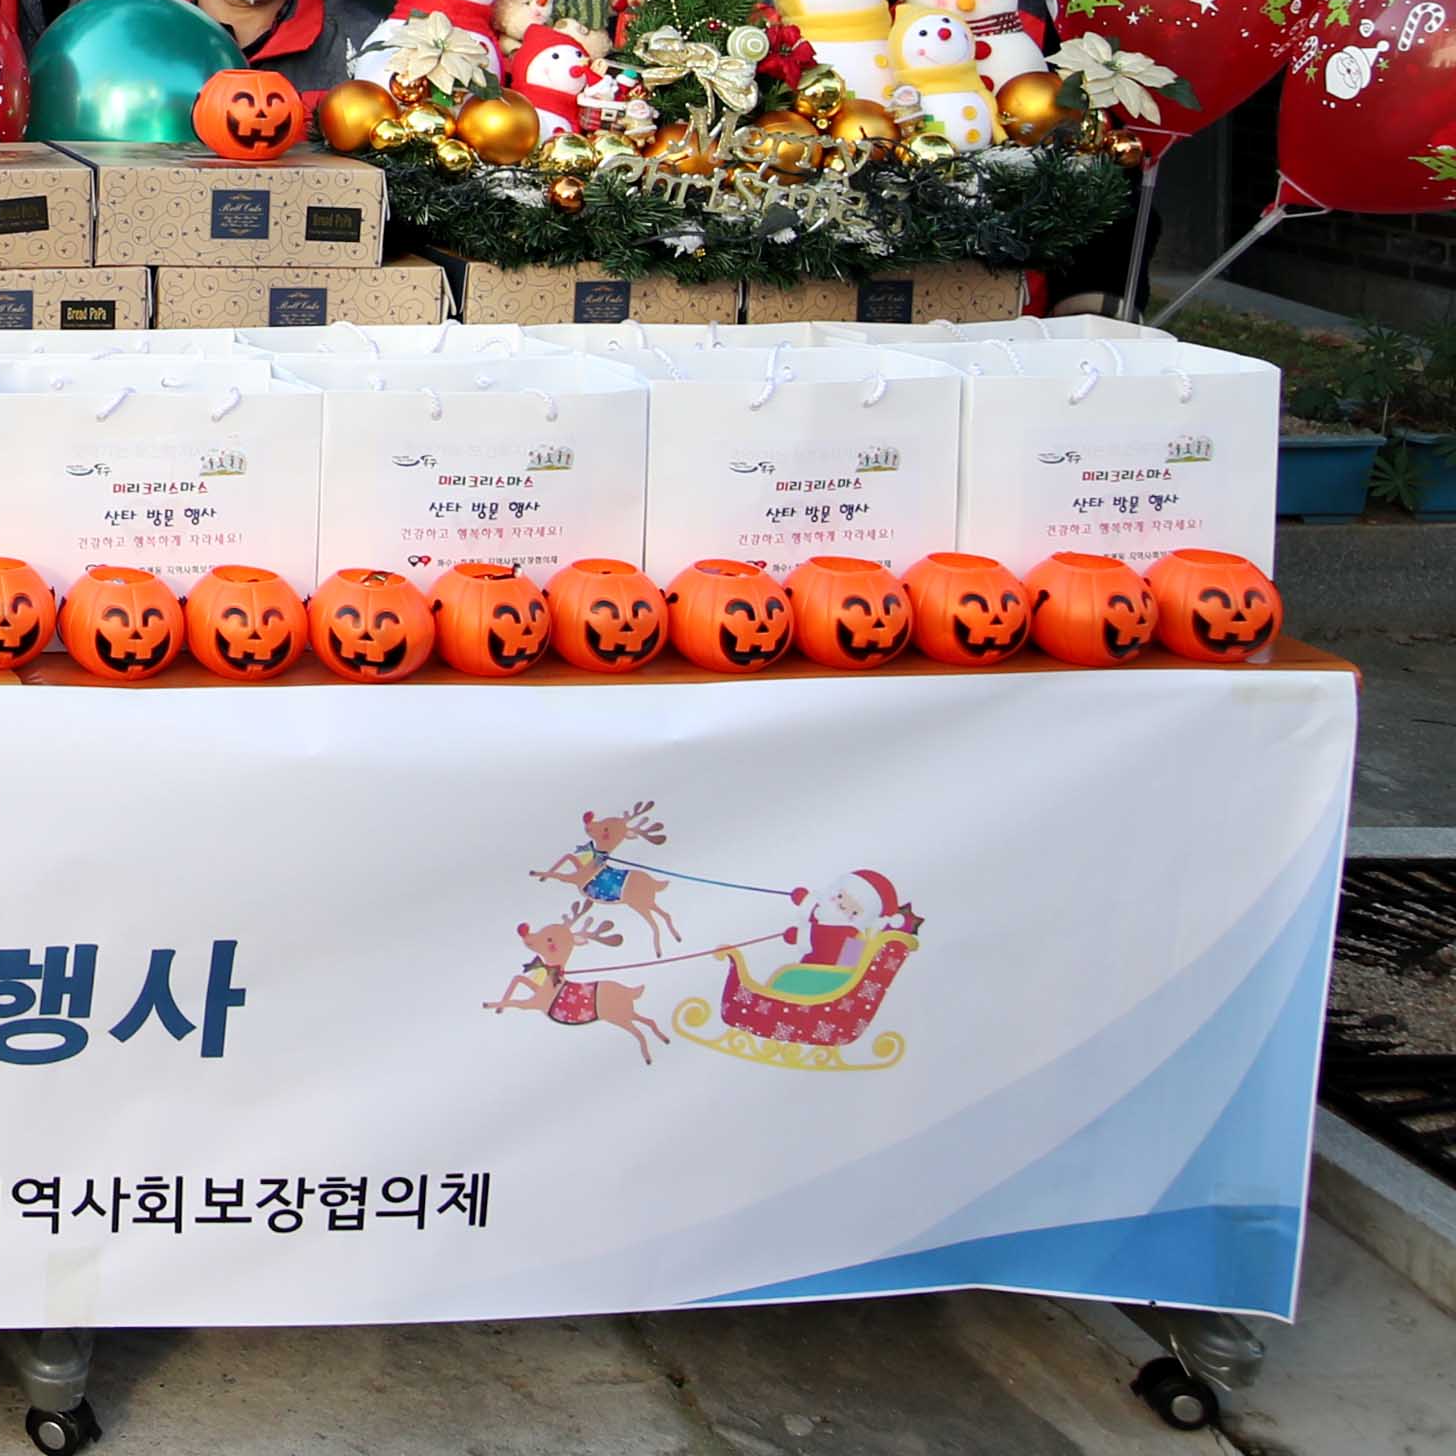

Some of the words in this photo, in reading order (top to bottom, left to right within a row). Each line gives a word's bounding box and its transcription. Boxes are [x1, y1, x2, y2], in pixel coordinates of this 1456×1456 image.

[668, 104, 873, 188] Merry
[67, 307, 87, 320] Bread
[439, 476, 533, 487] 미리크리스마스
[1082, 469, 1172, 482] 미리크리스마스
[113, 482, 208, 494] 미리크리스마스
[776, 478, 863, 492] 미리크리스마스
[429, 502, 462, 517] 산타
[472, 502, 499, 519] 방문
[509, 502, 540, 518] 행사
[1073, 497, 1104, 513] 산타
[1113, 496, 1139, 513] 방문
[1149, 494, 1179, 511] 행사
[105, 510, 136, 526] 산타
[147, 509, 174, 526] 방문
[184, 508, 216, 525] 행사
[766, 507, 796, 523] 산타
[805, 506, 831, 522] 방문
[840, 504, 870, 521] 행사
[401, 528, 449, 539] 건강하고
[457, 528, 503, 539] 행복하게
[512, 527, 564, 538] 자라세요!
[1047, 524, 1091, 537] 건강하고
[1099, 522, 1144, 534] 행복하게
[1152, 520, 1203, 532] 자라세요!
[78, 537, 125, 549] 건강하고
[134, 535, 181, 548] 행복하게
[190, 534, 243, 545] 자라세요!
[739, 533, 784, 545] 건강하고
[792, 530, 836, 543] 행복하게
[843, 529, 895, 540] 자라세요!
